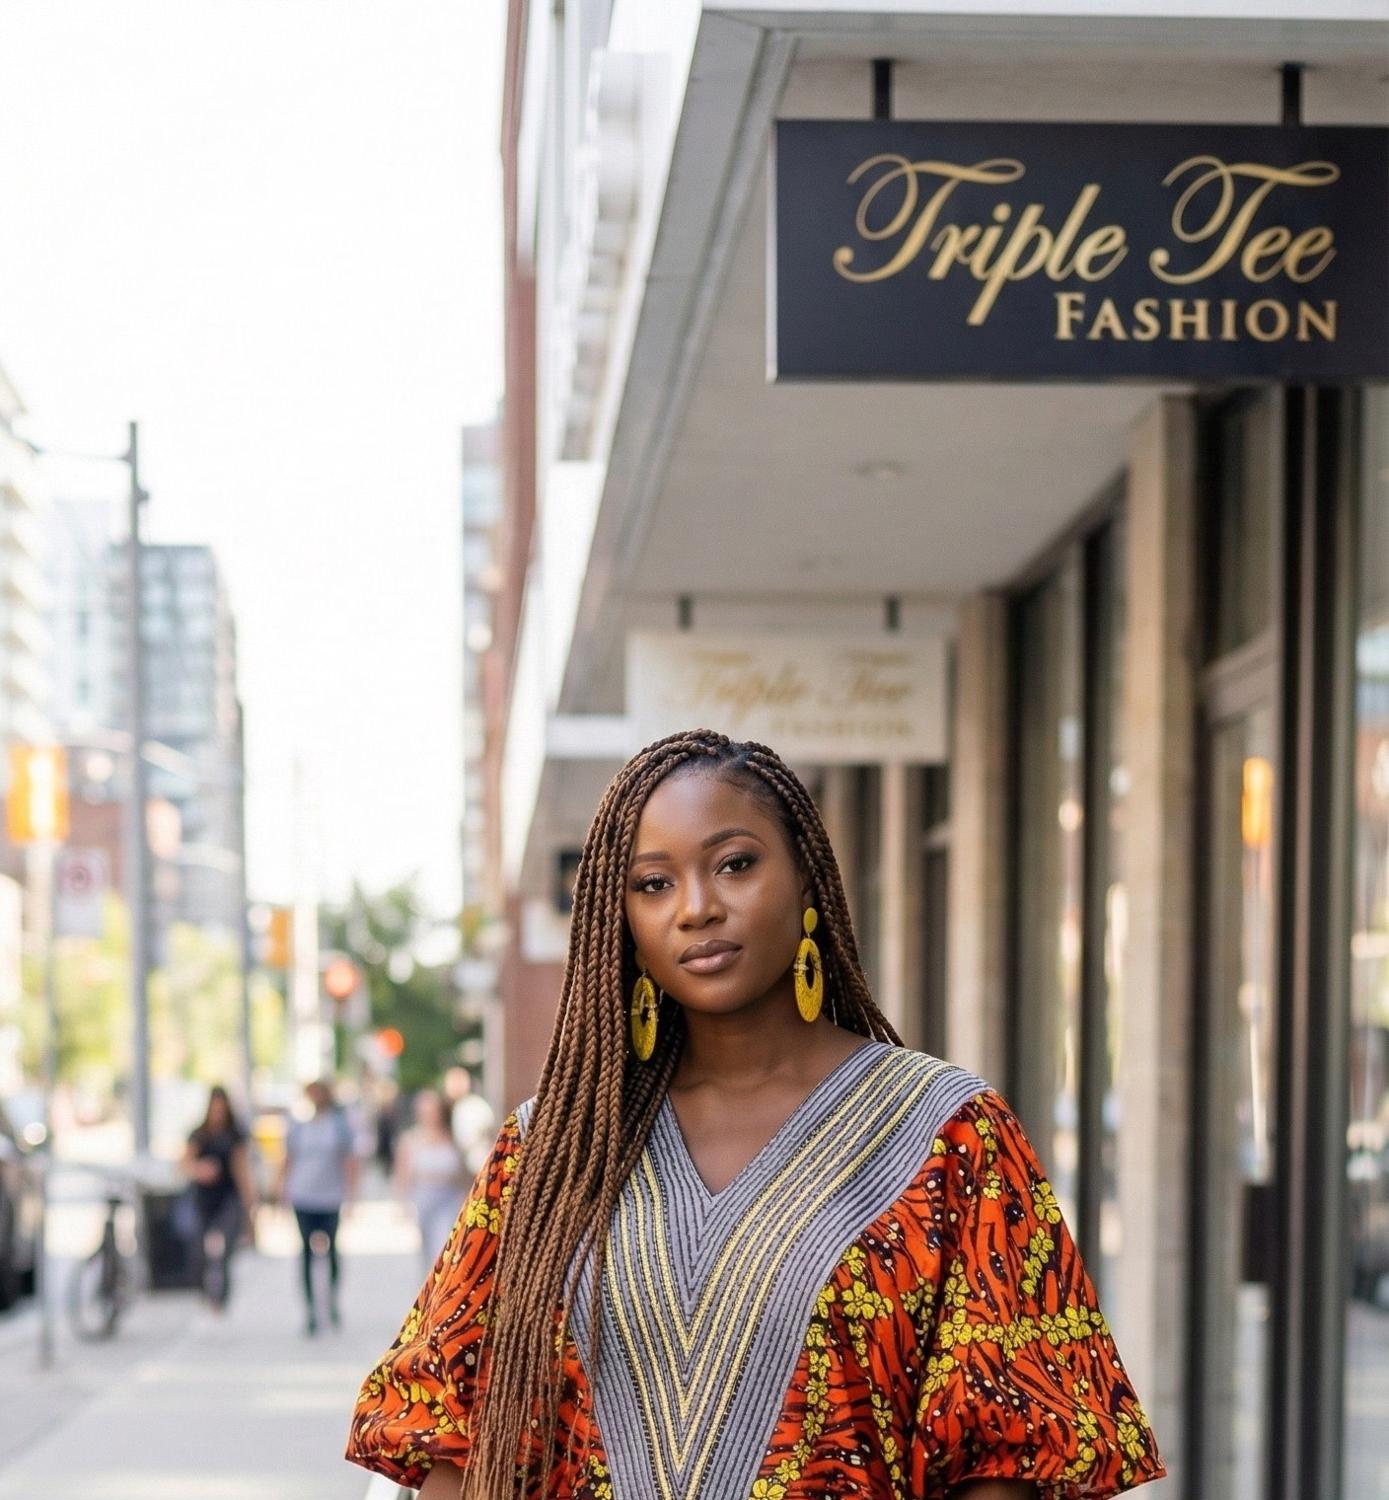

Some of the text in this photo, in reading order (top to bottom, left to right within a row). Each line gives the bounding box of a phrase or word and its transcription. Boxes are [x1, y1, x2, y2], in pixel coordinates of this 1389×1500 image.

[833, 153, 1341, 326] Triple Tee
[1054, 292, 1338, 342] FASHION
